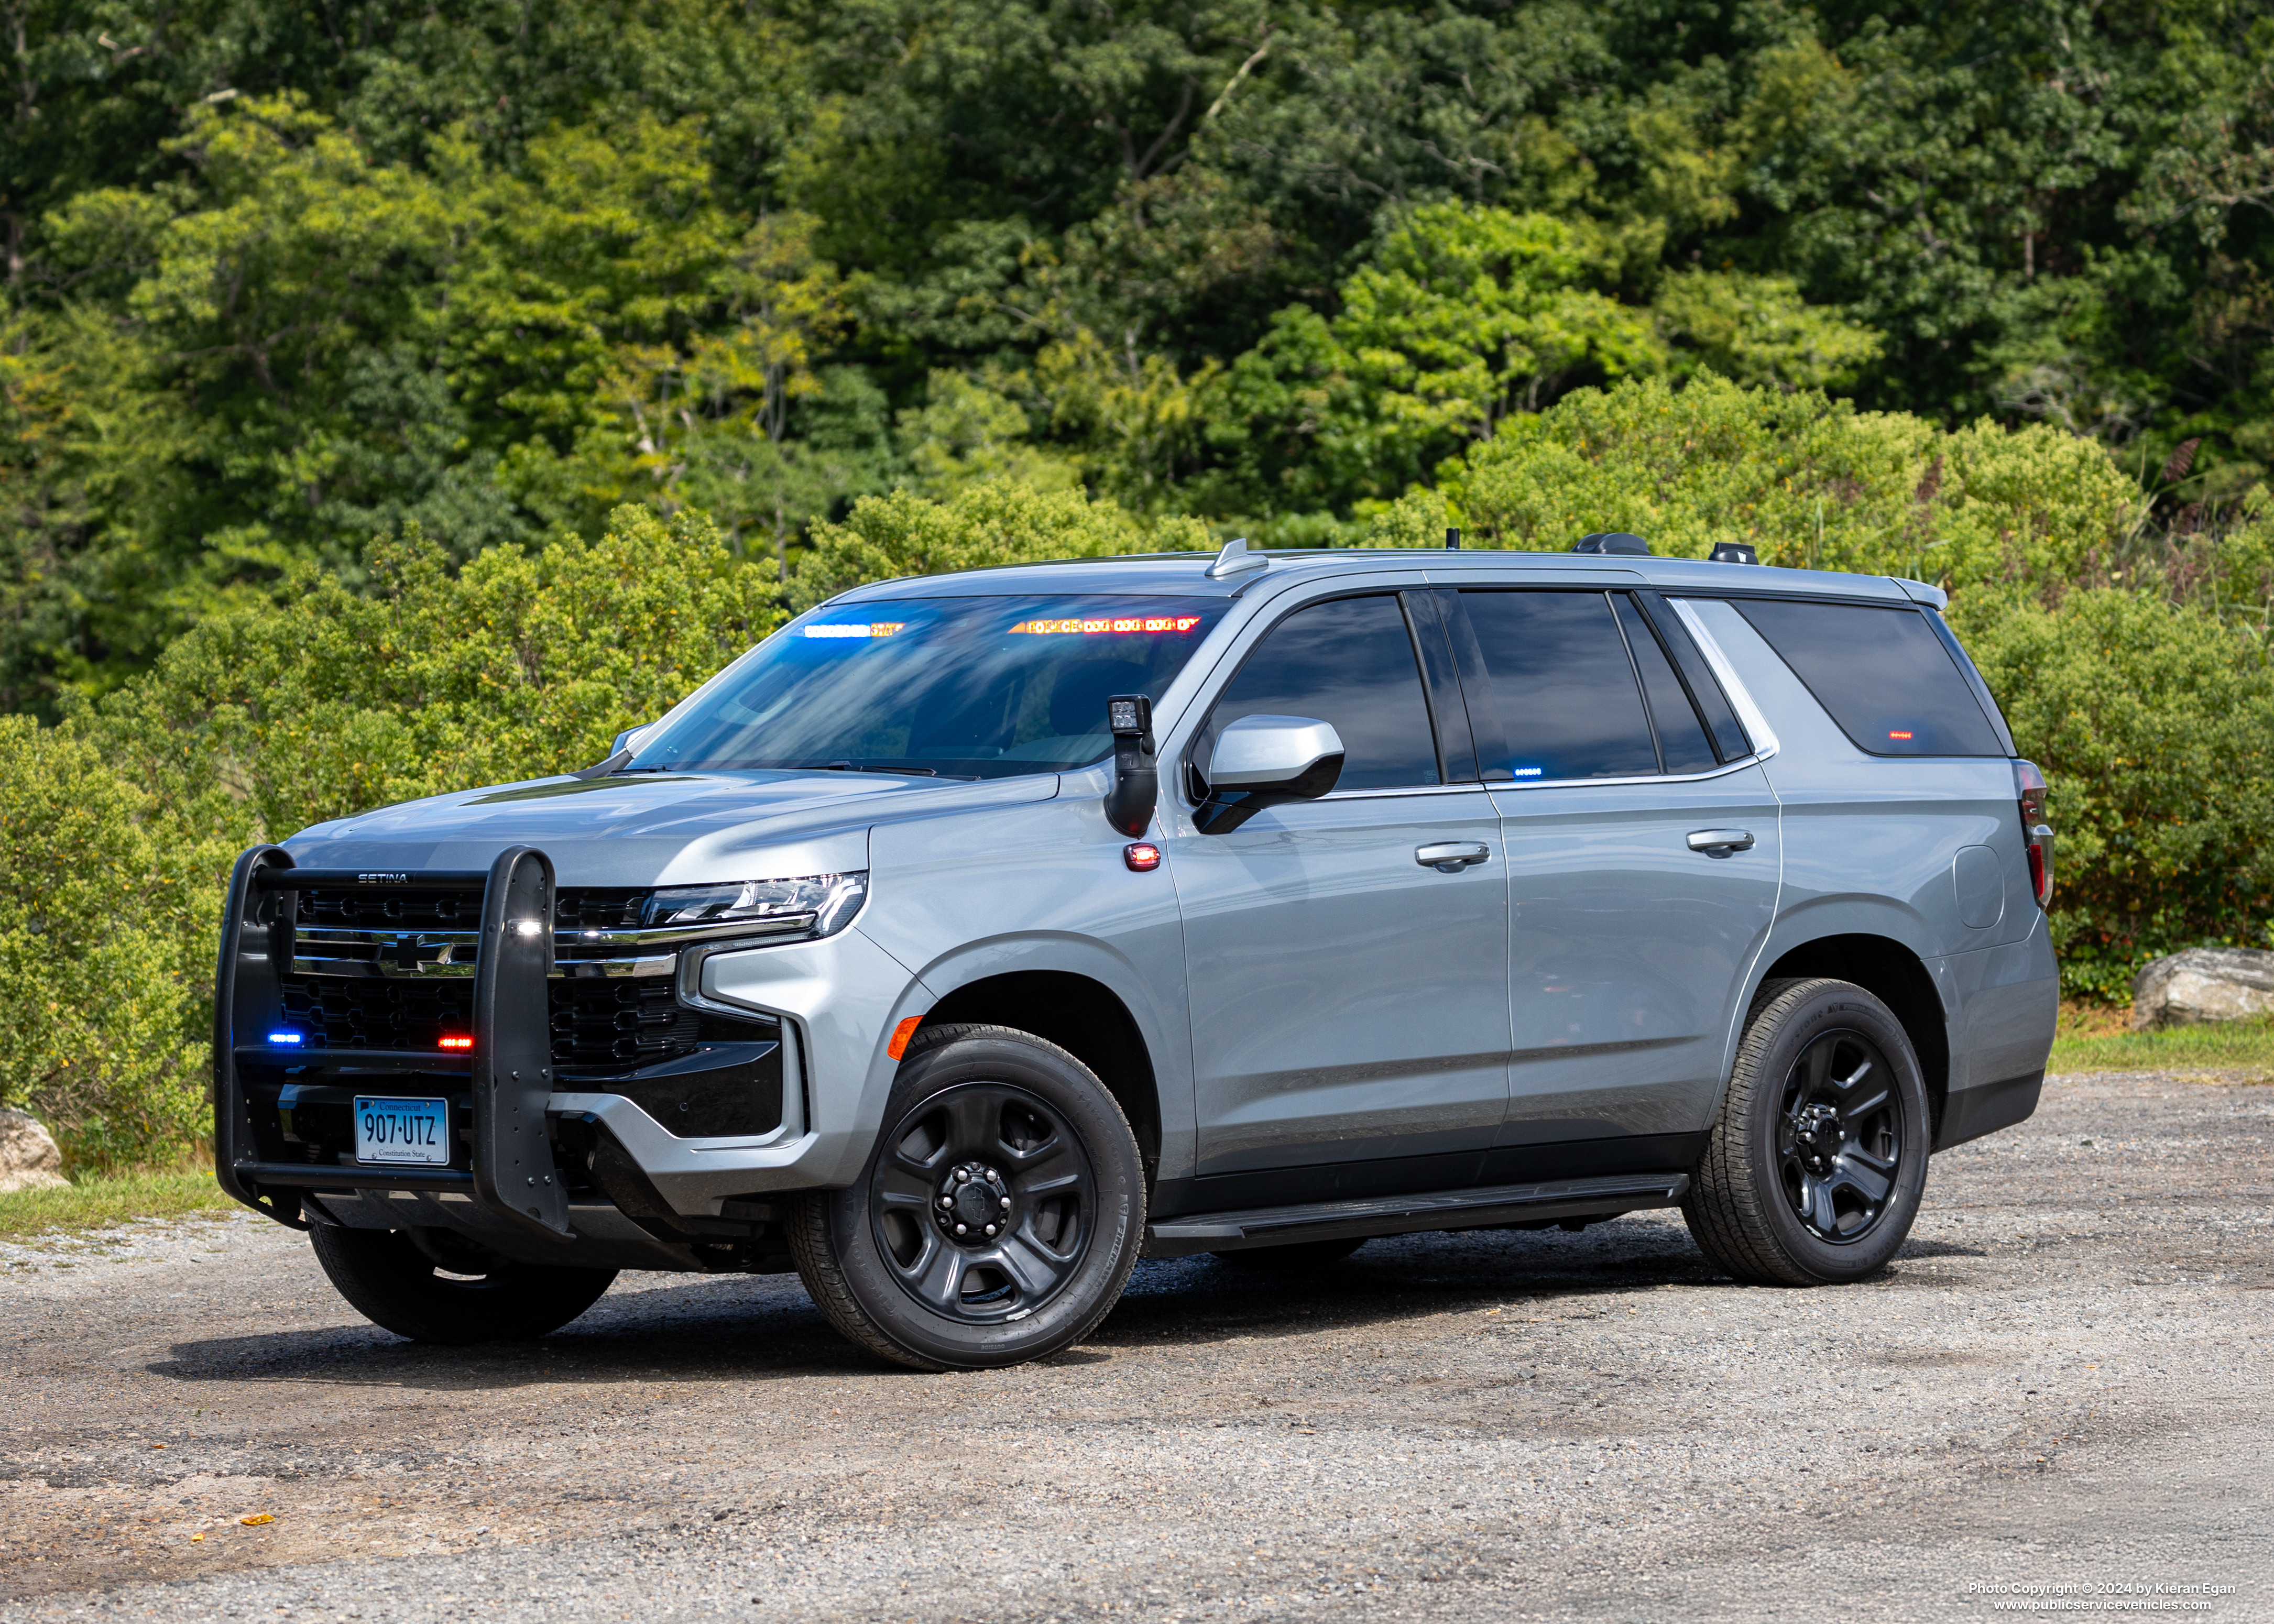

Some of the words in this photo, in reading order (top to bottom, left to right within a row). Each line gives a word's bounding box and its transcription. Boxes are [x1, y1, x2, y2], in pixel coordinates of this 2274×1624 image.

[358, 874, 408, 883] SETINA
[379, 1102, 421, 1112] Connecticut
[379, 1149, 411, 1157] Constitution
